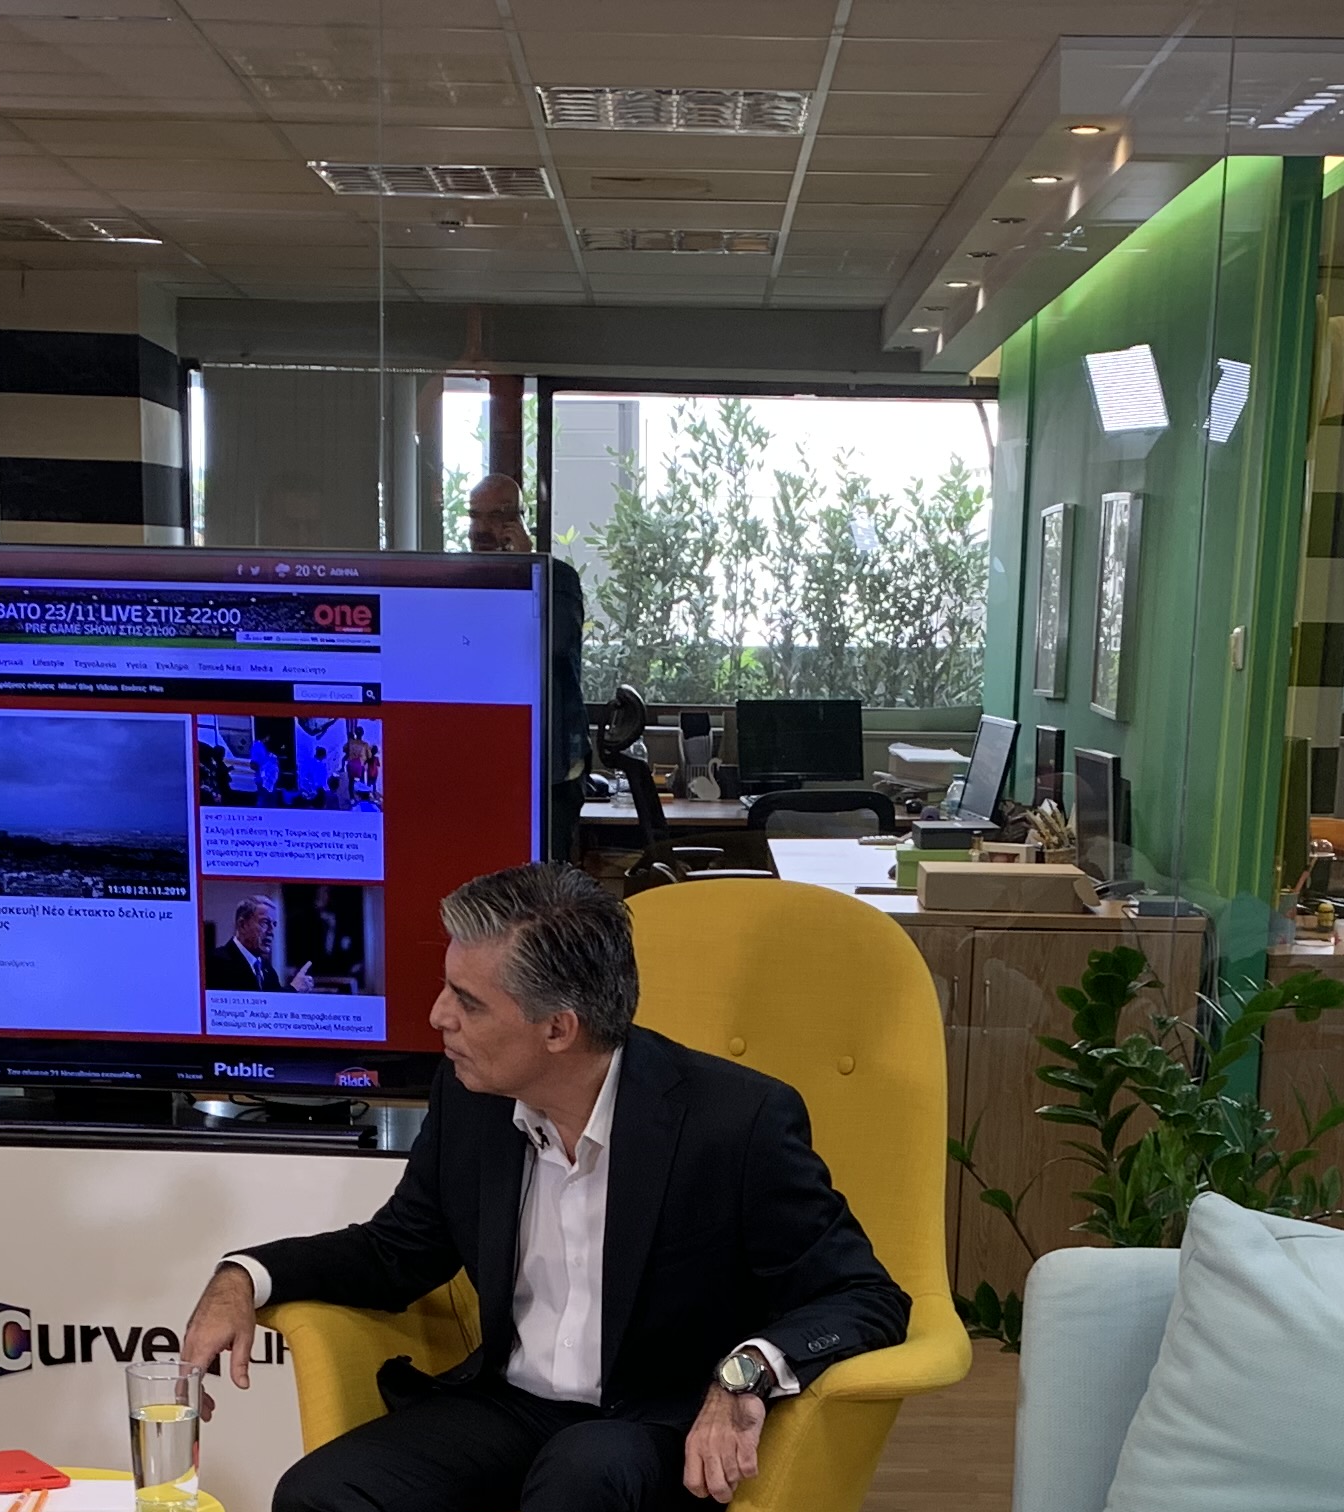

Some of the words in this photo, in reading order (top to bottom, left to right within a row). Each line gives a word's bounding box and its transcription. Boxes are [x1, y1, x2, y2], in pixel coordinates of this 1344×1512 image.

[295, 565, 310, 577] 20
[45, 602, 96, 622] 23/11
[101, 605, 142, 622] LIVE
[146, 606, 186, 623] ΣΤΙΣ
[190, 608, 241, 624] 22:00
[314, 604, 372, 626] one
[25, 623, 46, 633] PRE
[49, 624, 81, 634] GAME
[84, 625, 116, 635] SHOW
[119, 626, 144, 635] ΣΤΙΣ
[145, 626, 176, 636] 21:00
[138, 886, 186, 896] 21.11.2019
[42, 905, 65, 916] Νέο
[68, 906, 115, 917] έκτακτο
[118, 907, 156, 919] δελτίο
[159, 911, 173, 921] με
[214, 1062, 275, 1078] Public
[339, 1074, 371, 1087] Black
